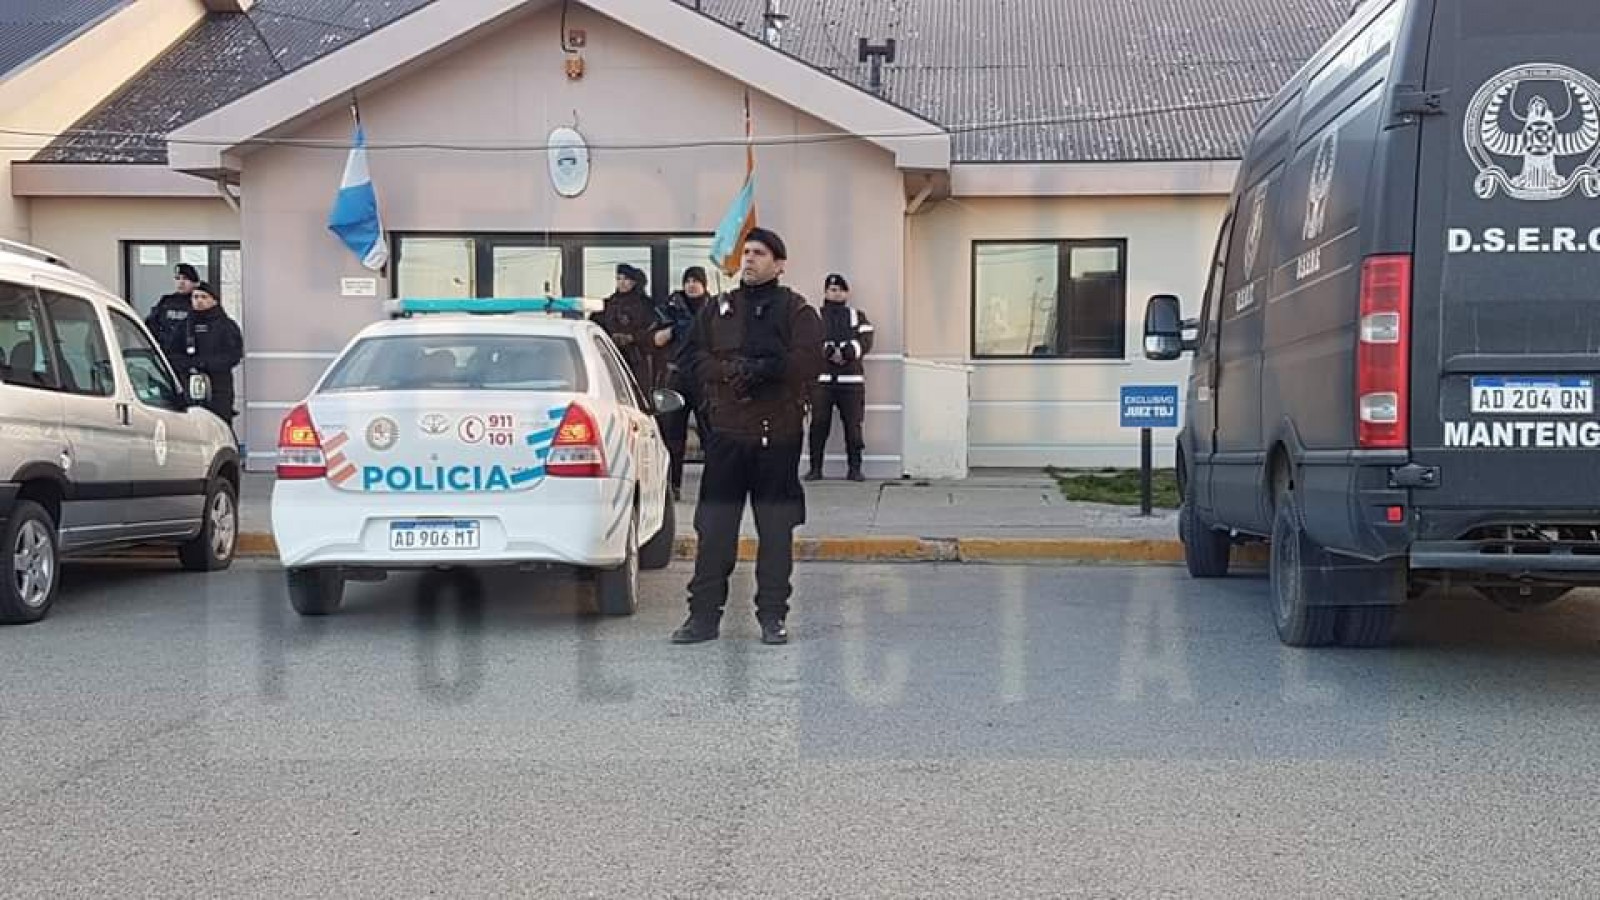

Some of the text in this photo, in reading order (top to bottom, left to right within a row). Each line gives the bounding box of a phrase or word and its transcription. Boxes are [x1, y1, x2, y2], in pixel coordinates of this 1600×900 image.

[1479, 389, 1586, 409] AD 204 QN
[488, 414, 513, 428] 911
[488, 432, 514, 446] 101
[362, 465, 510, 491] POLICIA
[395, 531, 415, 547] AD
[420, 530, 450, 546] 906
